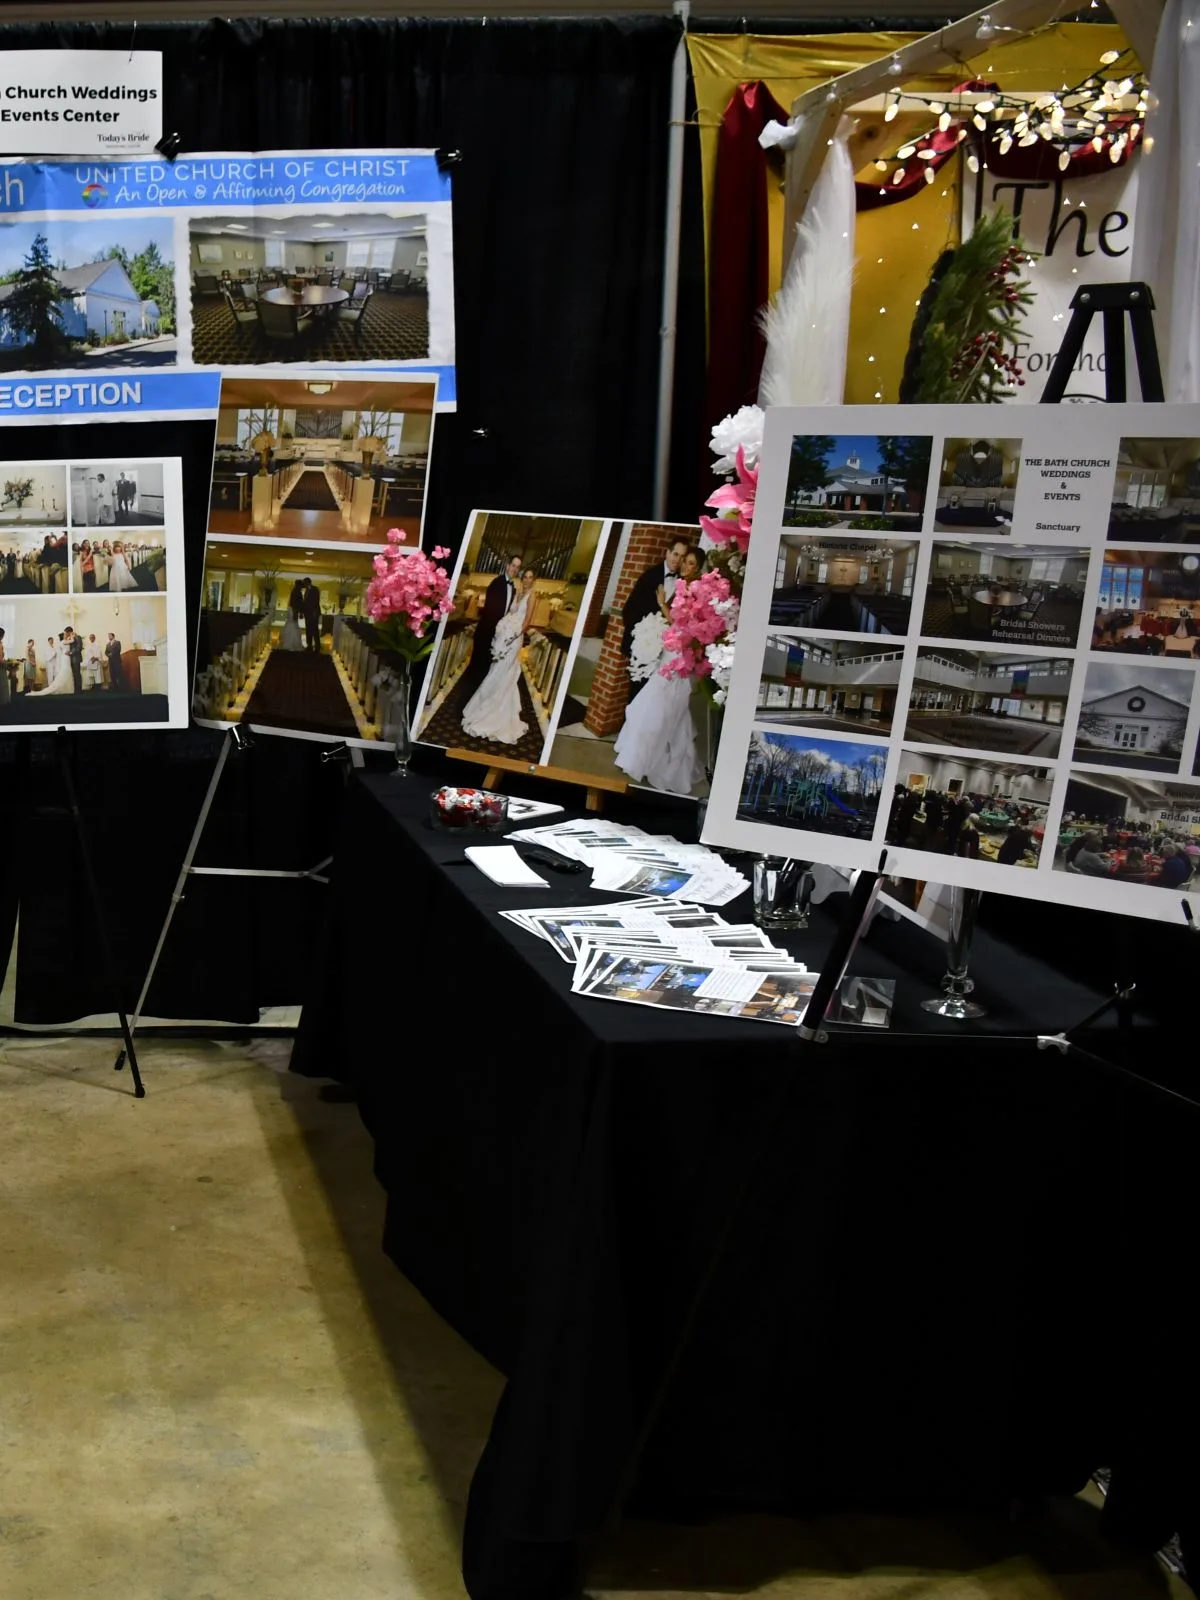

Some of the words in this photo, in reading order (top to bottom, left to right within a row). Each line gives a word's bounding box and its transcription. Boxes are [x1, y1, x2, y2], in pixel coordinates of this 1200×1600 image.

[5, 85, 67, 99] Church
[71, 85, 157, 102] Weddings
[1, 108, 59, 122] Events
[63, 108, 120, 122] Center
[75, 164, 165, 184] UNITED
[174, 162, 274, 180] CHURCH
[284, 161, 314, 178] OF
[325, 159, 410, 177] CHRIST
[115, 185, 141, 203] An
[146, 183, 188, 206] Open
[213, 181, 296, 204] Affirming
[301, 179, 406, 202] Congregation
[993, 179, 1129, 257] The
[1025, 458, 1042, 467] THE
[1044, 458, 1068, 467] BATH
[1070, 459, 1110, 467] CHURCH
[1040, 470, 1091, 478] WEDDINGS
[1044, 493, 1081, 501] EVENTS
[1035, 522, 1081, 532] Sanctuary
[1000, 619, 1026, 629] Bridal
[1027, 620, 1065, 631] Showers
[992, 629, 1035, 640] Rehearsal
[1036, 632, 1071, 643] Dinners
[1161, 812, 1189, 823] Bridal
